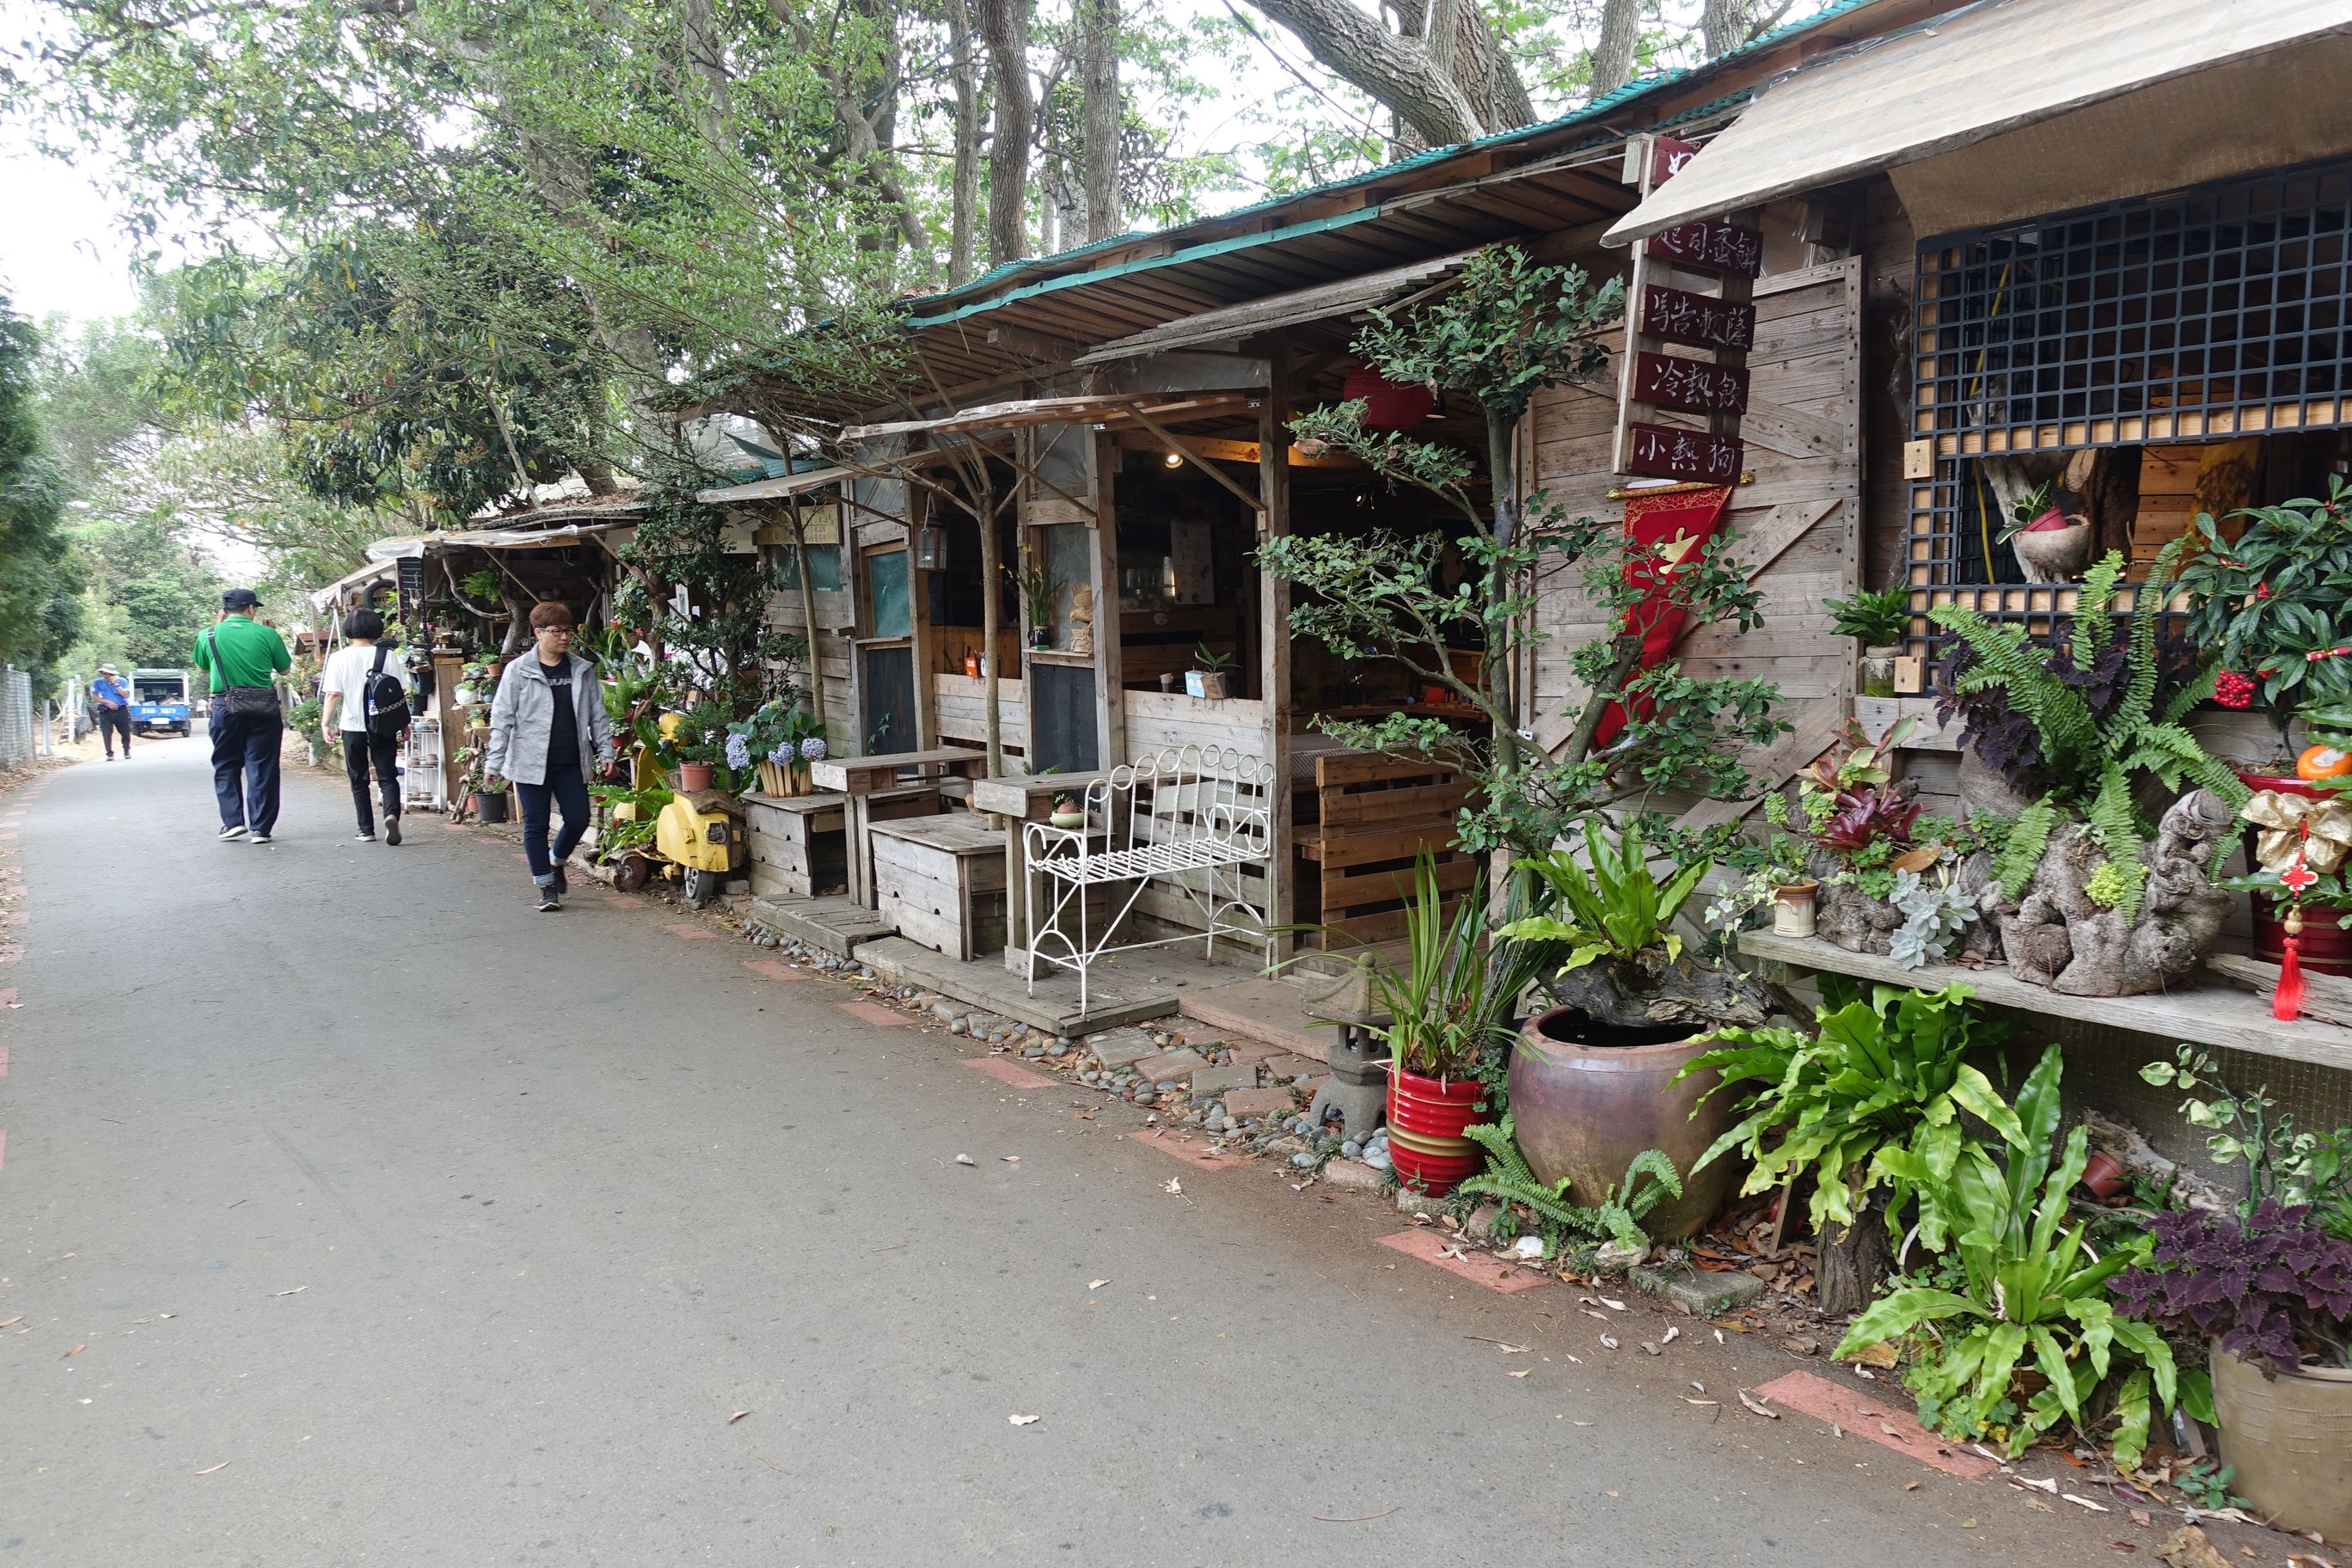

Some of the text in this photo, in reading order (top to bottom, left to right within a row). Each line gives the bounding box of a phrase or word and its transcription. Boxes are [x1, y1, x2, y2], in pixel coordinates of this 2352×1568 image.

[1651, 359, 1745, 413] 冷熱飲
[1638, 431, 1736, 476] 小熱狗
